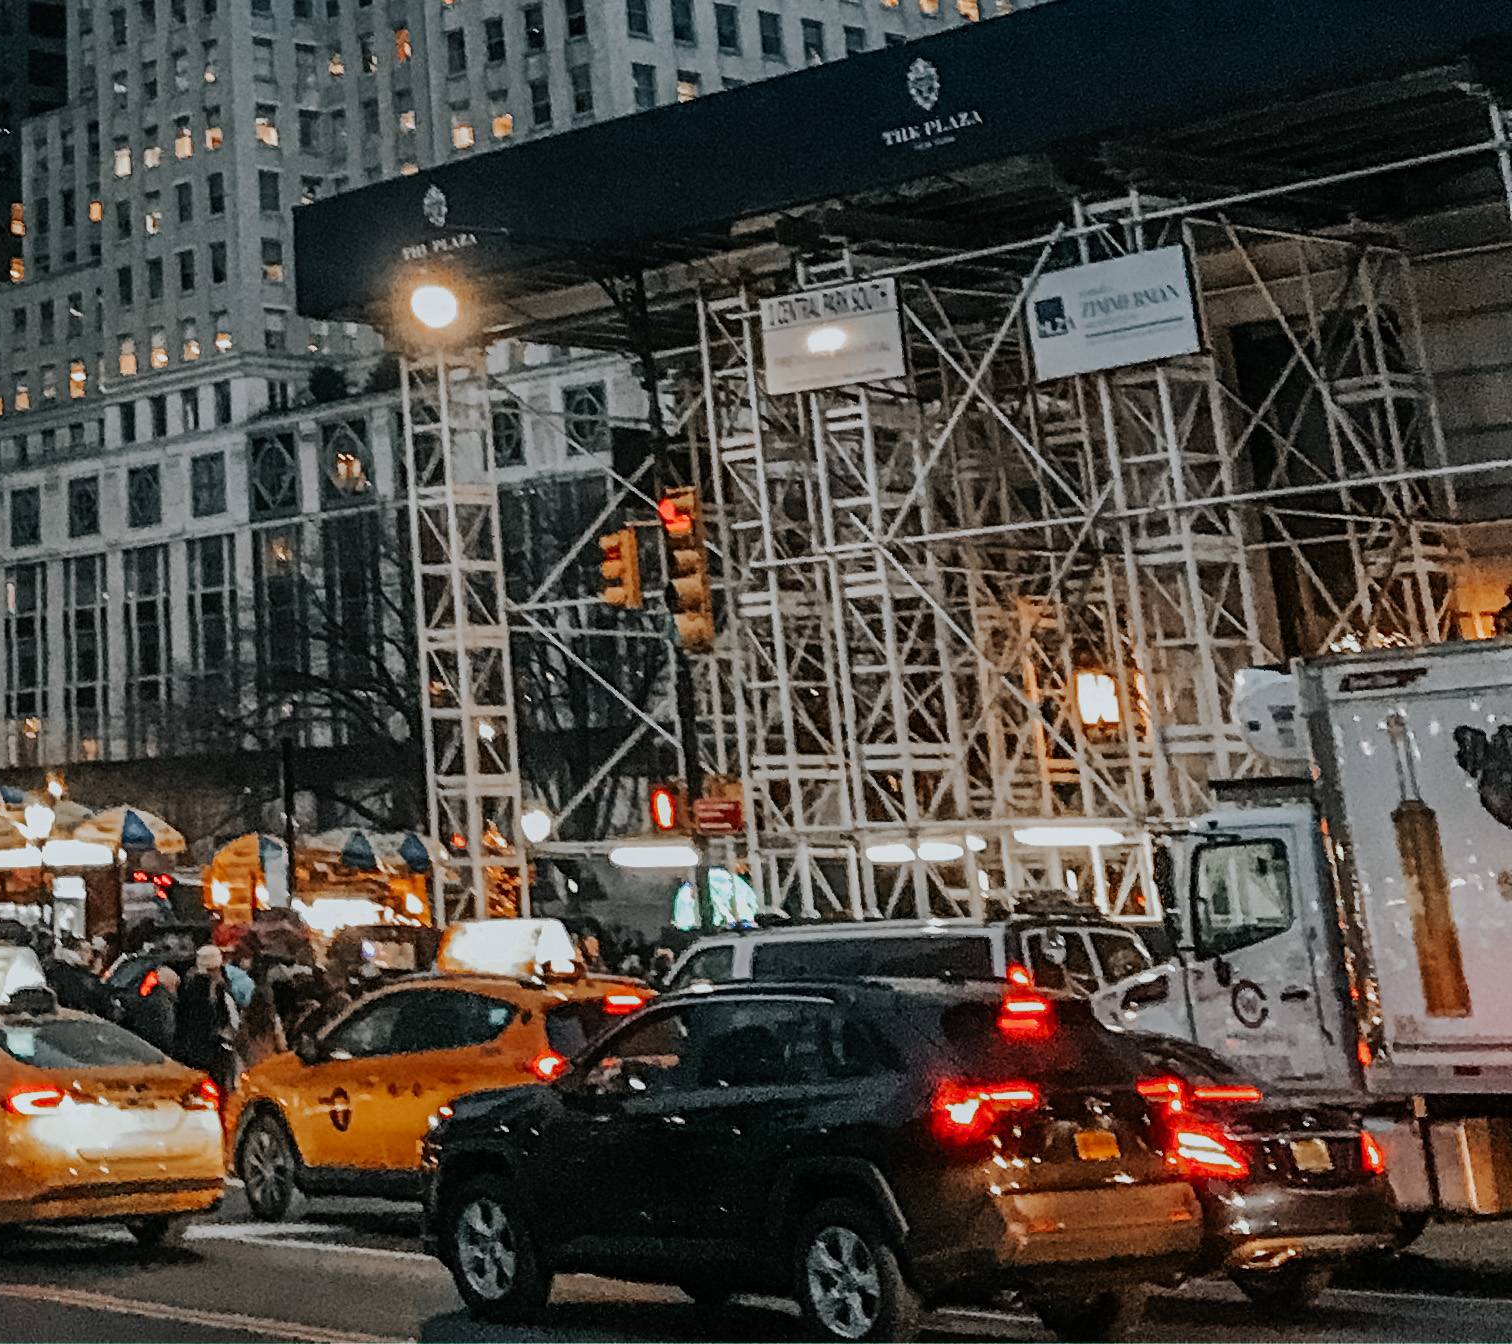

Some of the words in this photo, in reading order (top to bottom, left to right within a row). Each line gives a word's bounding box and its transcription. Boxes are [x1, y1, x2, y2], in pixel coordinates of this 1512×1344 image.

[881, 126, 920, 146] THE
[924, 110, 983, 136] PLAZA
[431, 233, 478, 253] PLAZA
